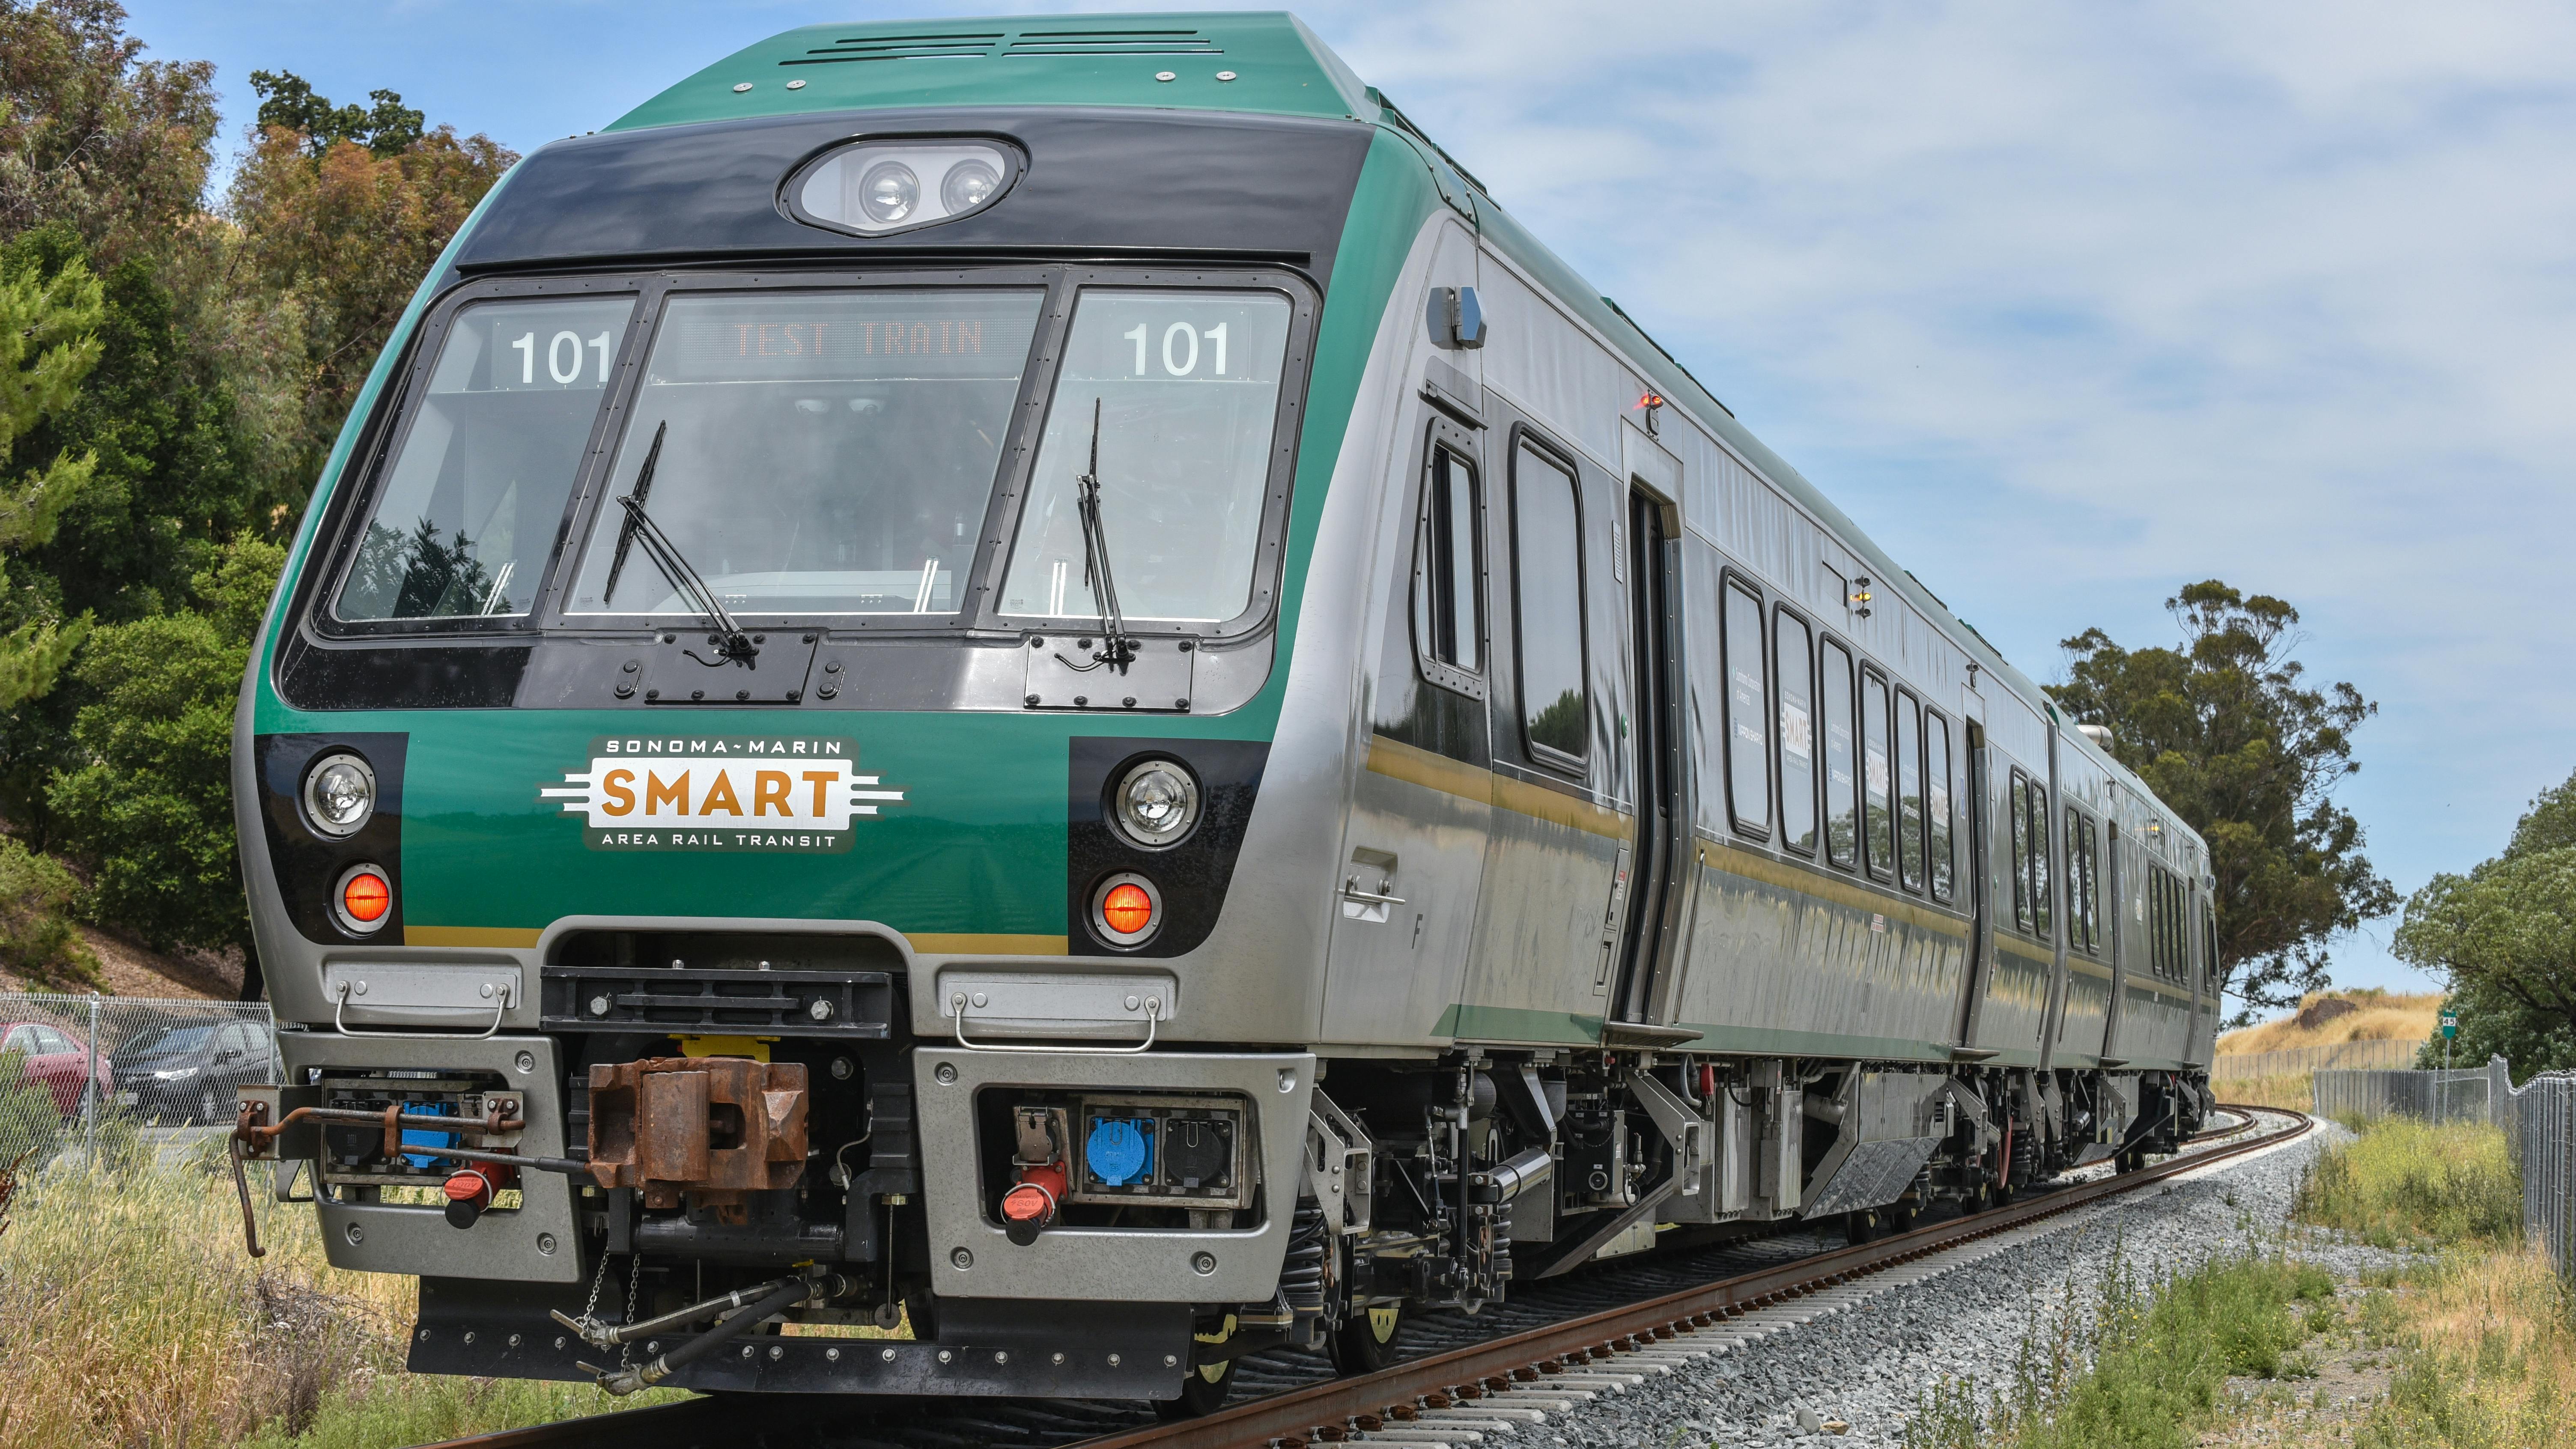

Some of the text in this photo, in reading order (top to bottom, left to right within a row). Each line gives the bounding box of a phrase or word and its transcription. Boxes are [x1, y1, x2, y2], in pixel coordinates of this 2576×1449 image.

[734, 321, 981, 355] TEST TRAIN
[1124, 322, 1227, 376] 101
[513, 331, 610, 384] 101
[1738, 723, 1763, 746] NIPPON SHARYO
[1785, 710, 1807, 751] SMART
[1869, 755, 1885, 790] SMART
[601, 768, 839, 818] SMART
[602, 834, 836, 847] AREA RAIL TRANSIT
